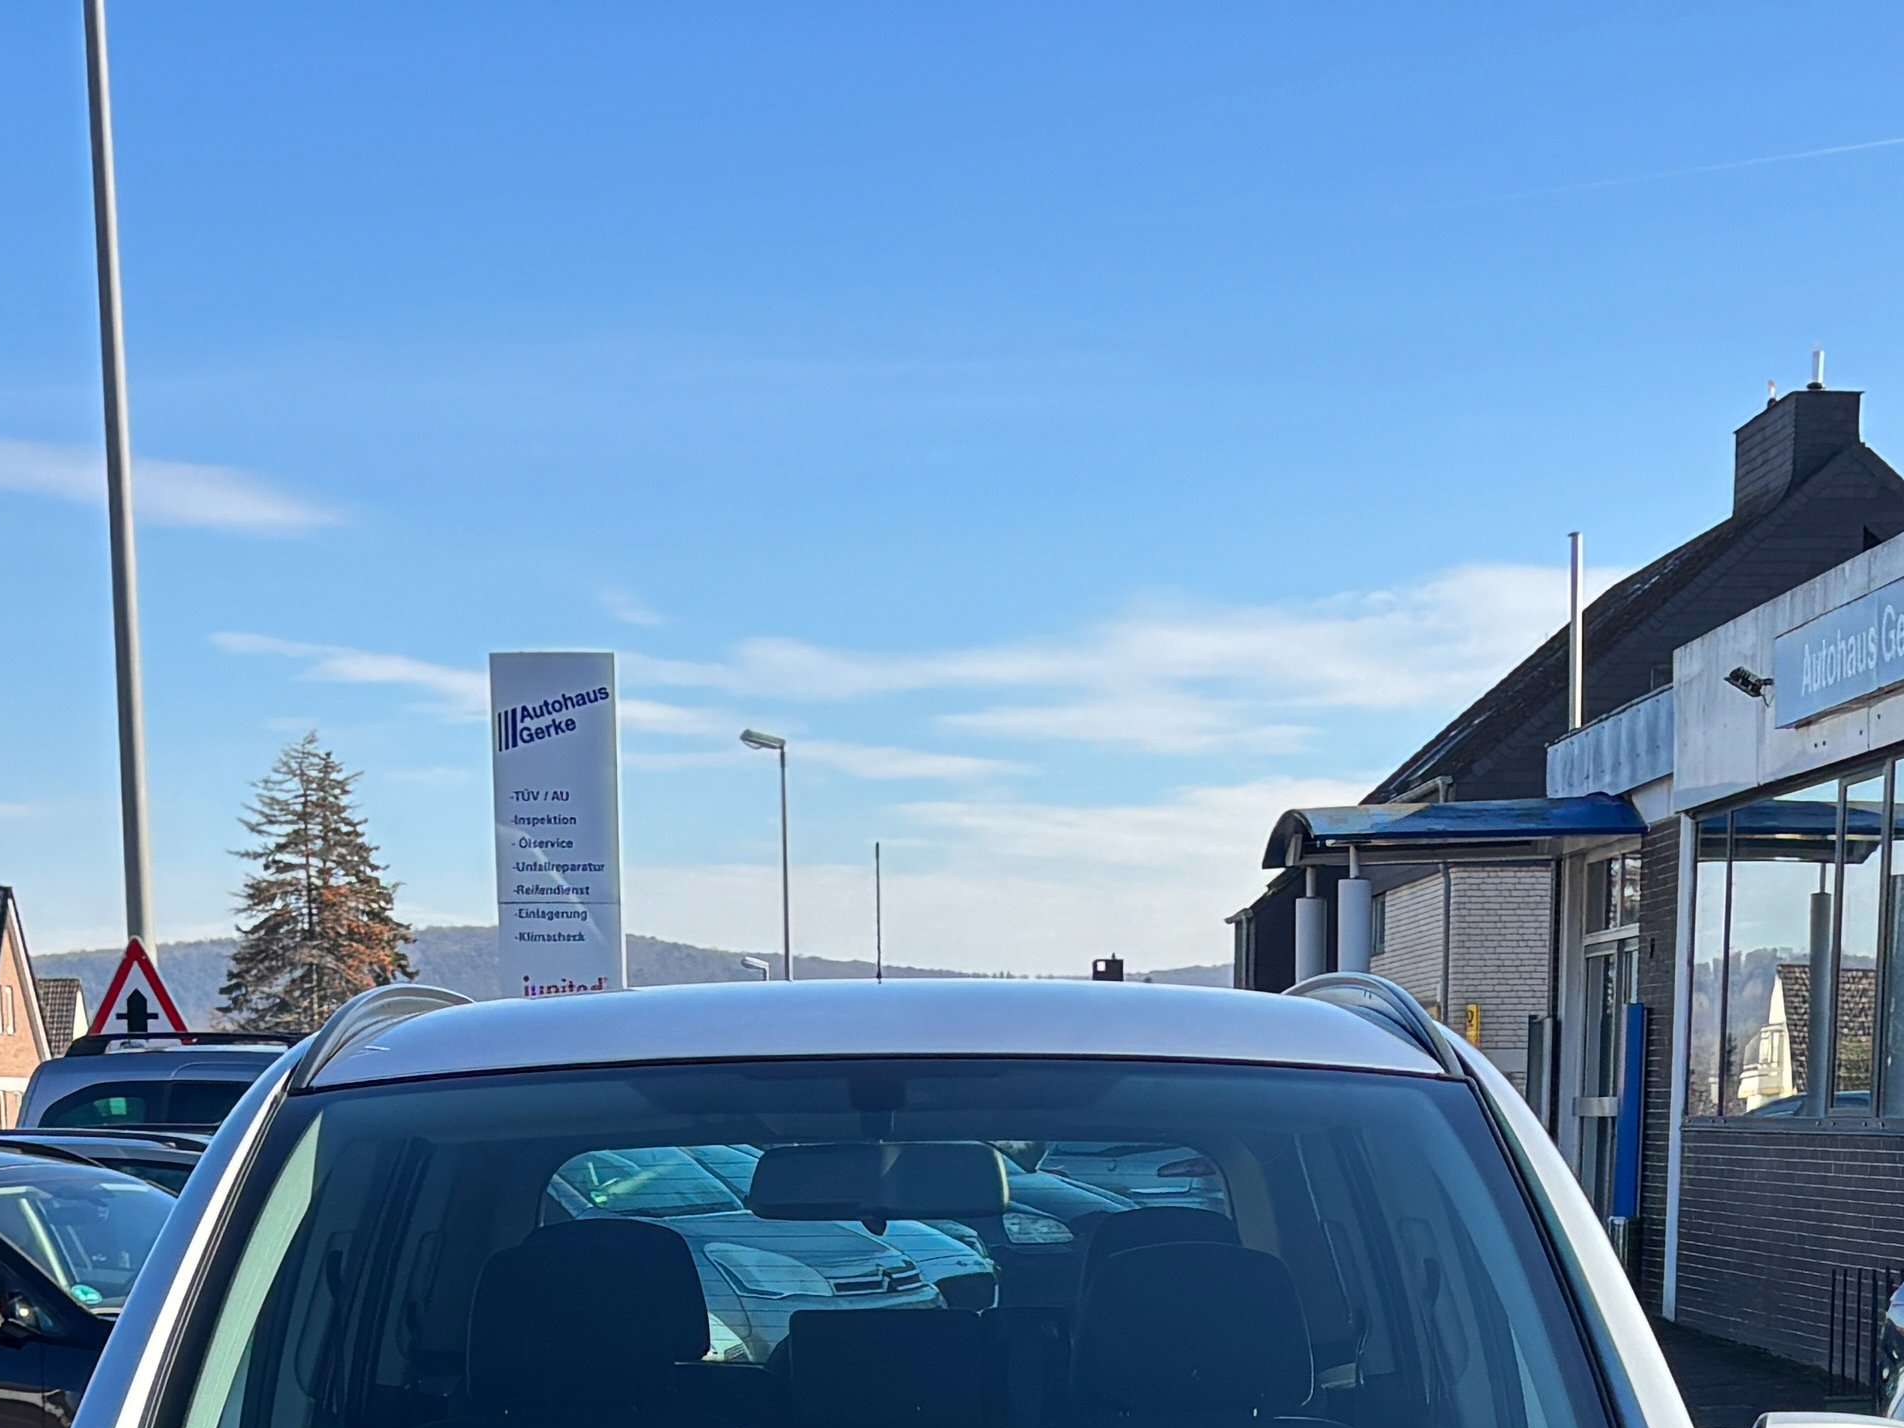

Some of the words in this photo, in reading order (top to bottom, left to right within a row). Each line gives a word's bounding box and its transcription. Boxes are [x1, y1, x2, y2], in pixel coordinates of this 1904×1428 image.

[1801, 627, 1877, 697] Autohaus
[520, 687, 610, 723] Autohaus
[519, 718, 576, 744] Gerke
[551, 790, 570, 802] AU
[518, 836, 574, 848] Ölservice
